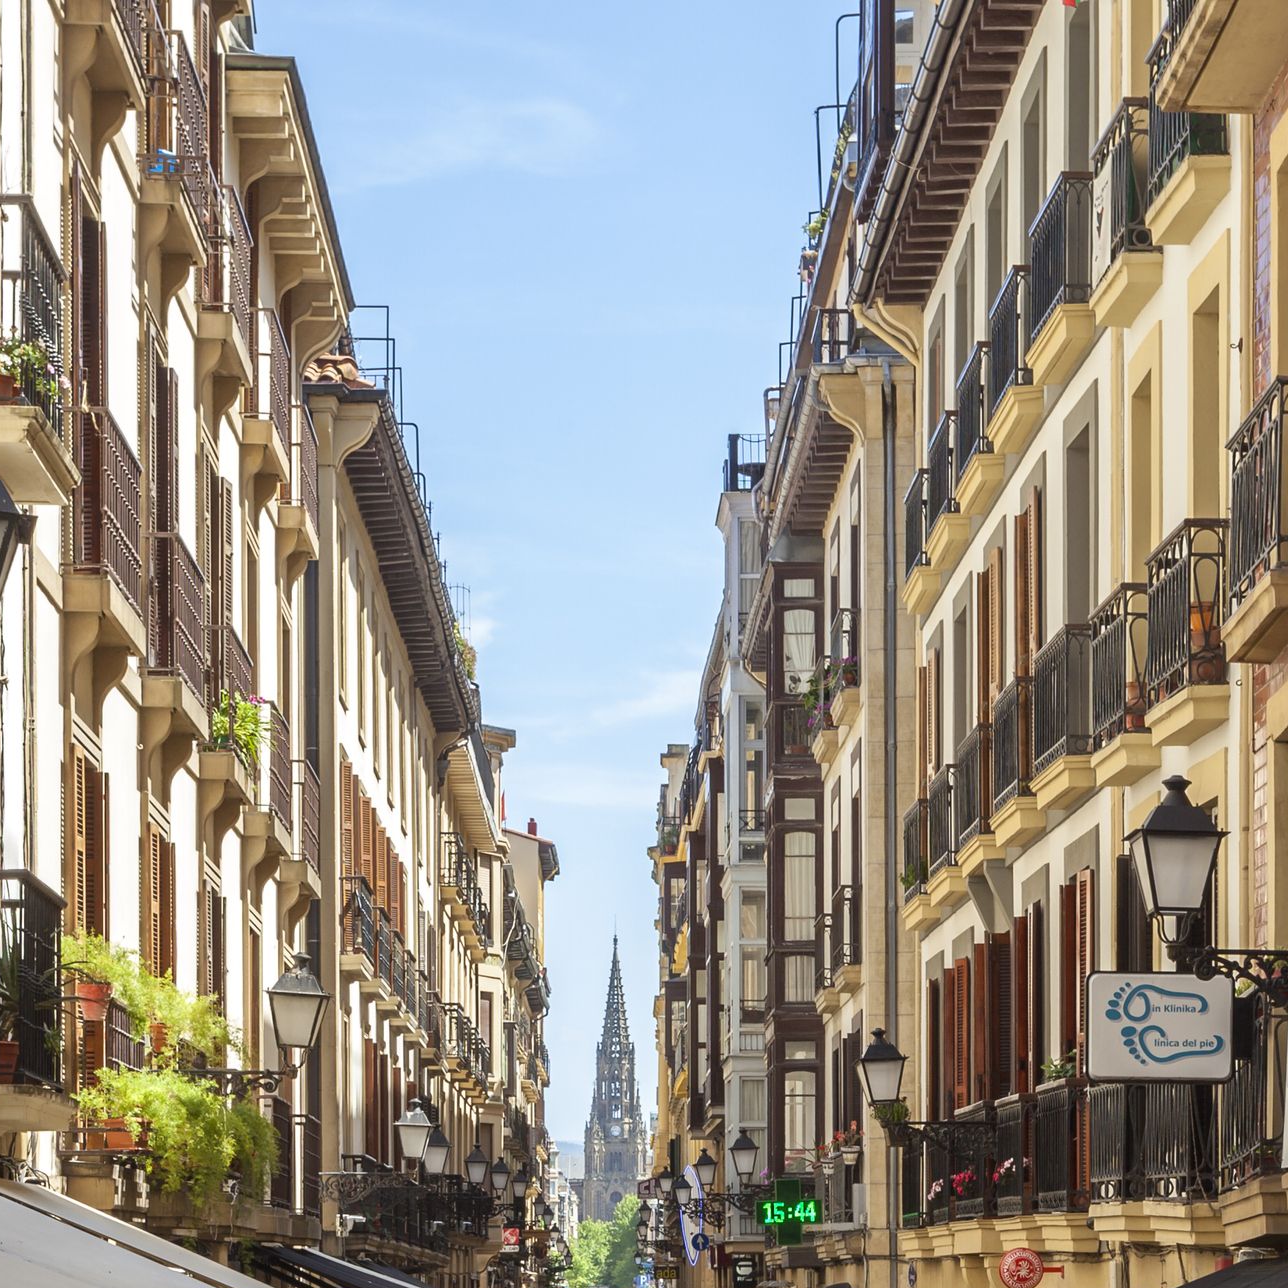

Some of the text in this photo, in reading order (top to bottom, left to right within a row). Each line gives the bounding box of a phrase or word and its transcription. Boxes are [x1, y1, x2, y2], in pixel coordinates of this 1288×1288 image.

[1164, 1004, 1196, 1013] Klinika
[1182, 1039, 1196, 1047] del
[1199, 1039, 1214, 1049] pie
[762, 1201, 817, 1224] 15:44
